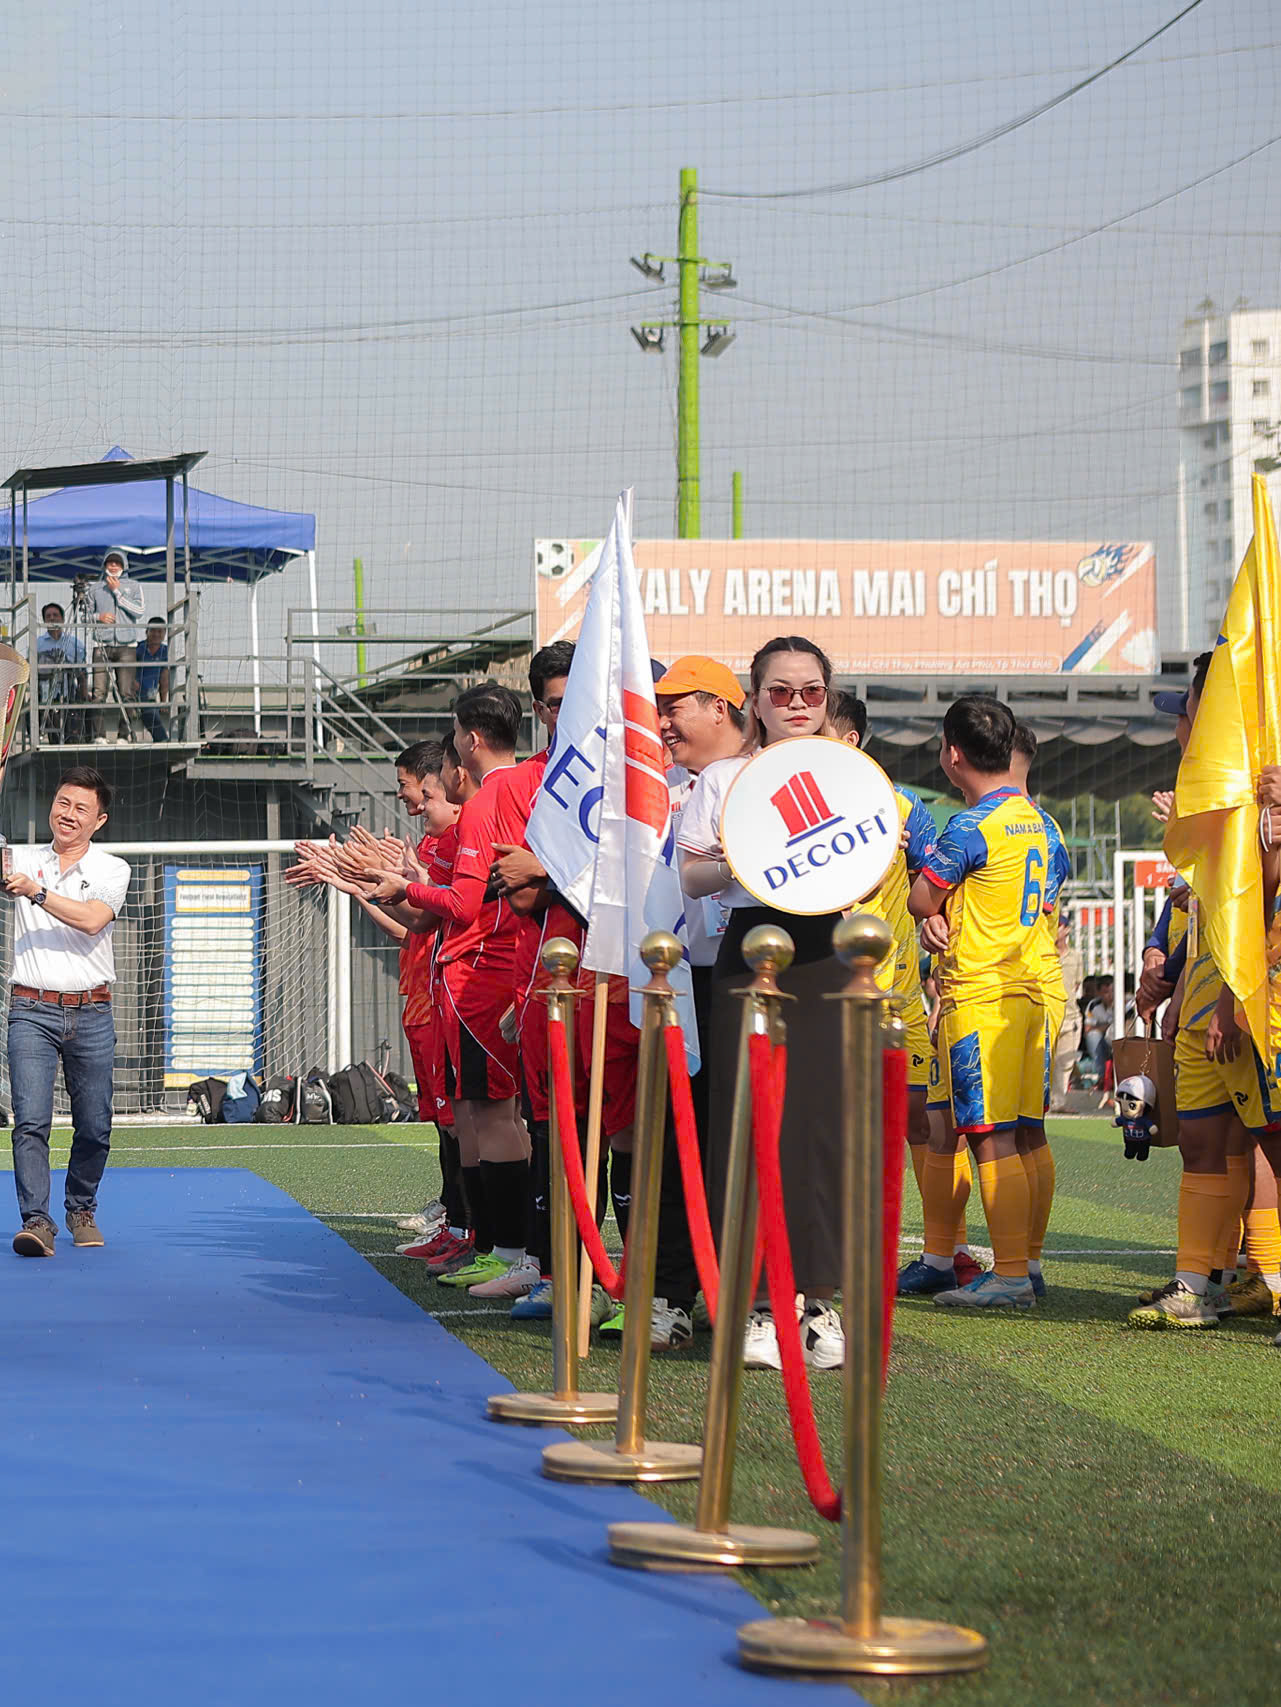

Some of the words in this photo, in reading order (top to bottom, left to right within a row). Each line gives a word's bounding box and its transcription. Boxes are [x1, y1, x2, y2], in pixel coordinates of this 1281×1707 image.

[723, 568, 841, 617] ARENA
[853, 569, 926, 618] MAI
[937, 558, 998, 618] CHÍ
[1008, 569, 1078, 627] THỌ
[763, 815, 887, 890] DECOFI
[1005, 823, 1025, 836] NAM
[1020, 846, 1044, 927] 6
